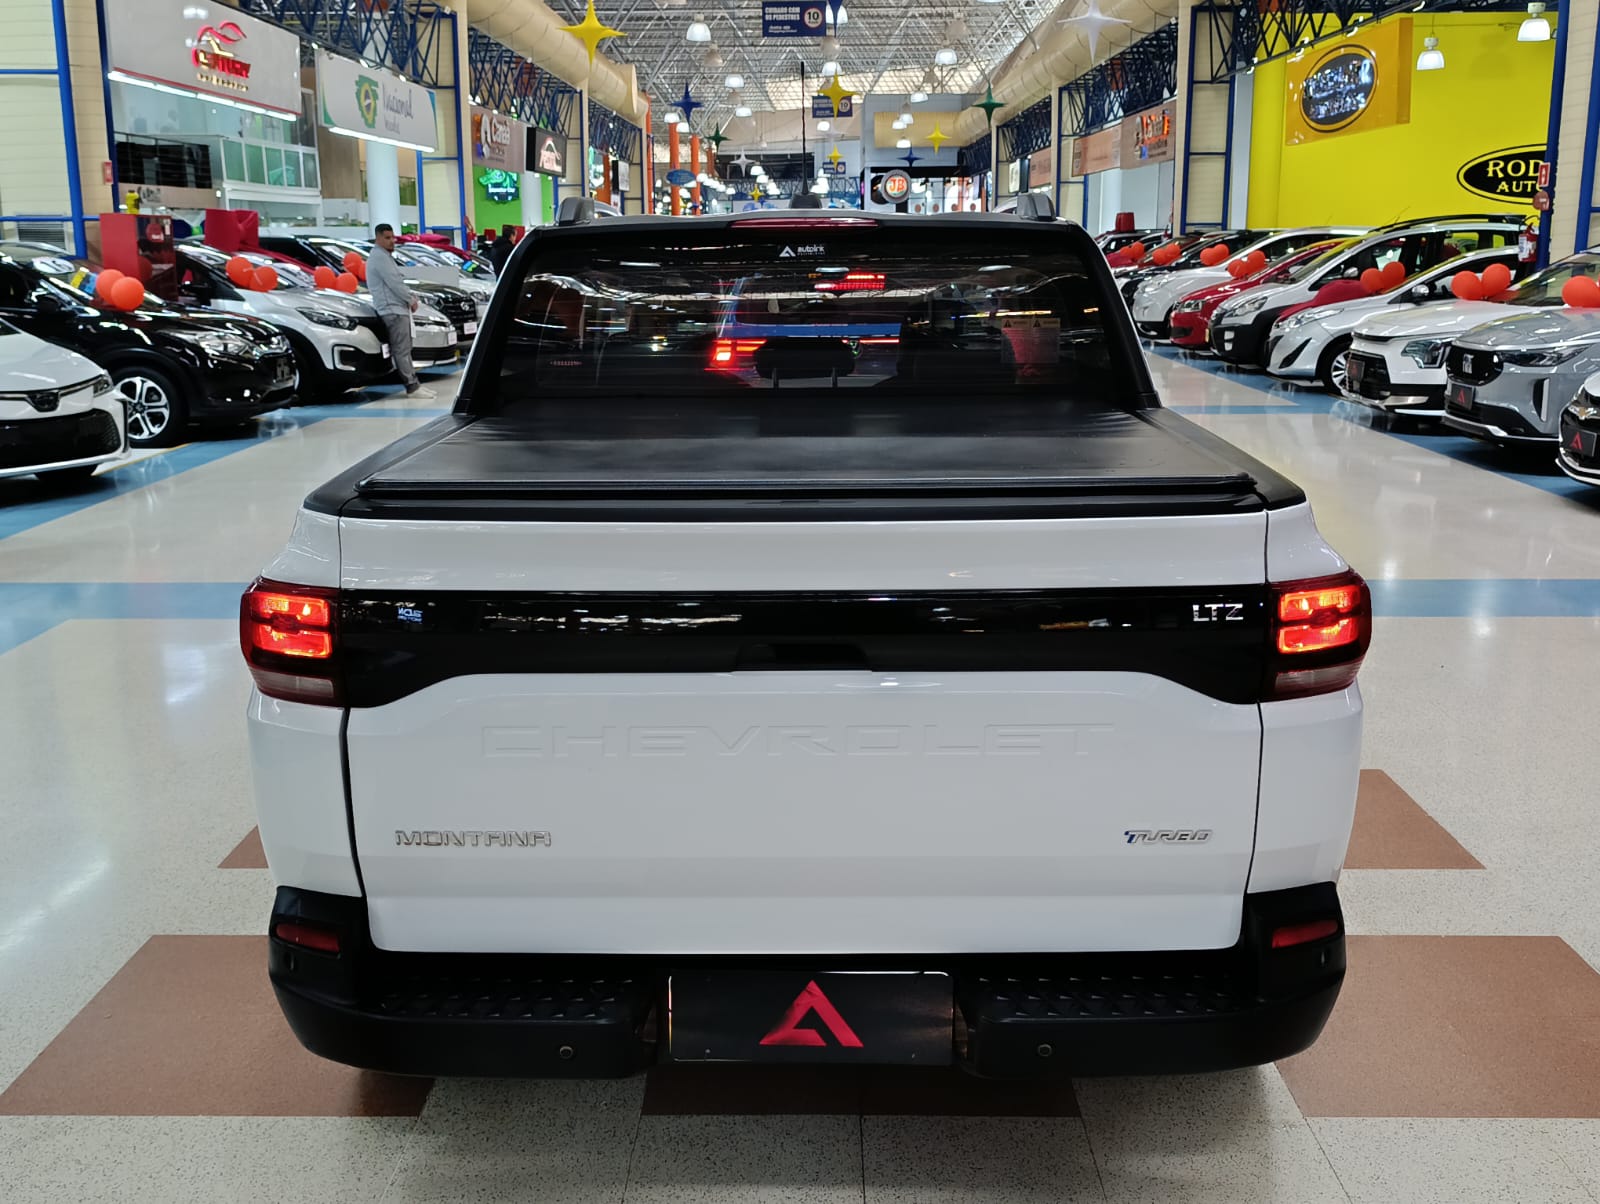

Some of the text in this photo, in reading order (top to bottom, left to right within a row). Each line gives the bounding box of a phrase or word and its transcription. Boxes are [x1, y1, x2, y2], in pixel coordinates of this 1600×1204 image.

[807, 11, 819, 20] 10
[889, 178, 905, 192] JB
[1192, 603, 1244, 622] LTZ
[481, 723, 1114, 759] CHEVROLET
[395, 829, 552, 848] MONTANA
[1124, 829, 1214, 847] TURBO
